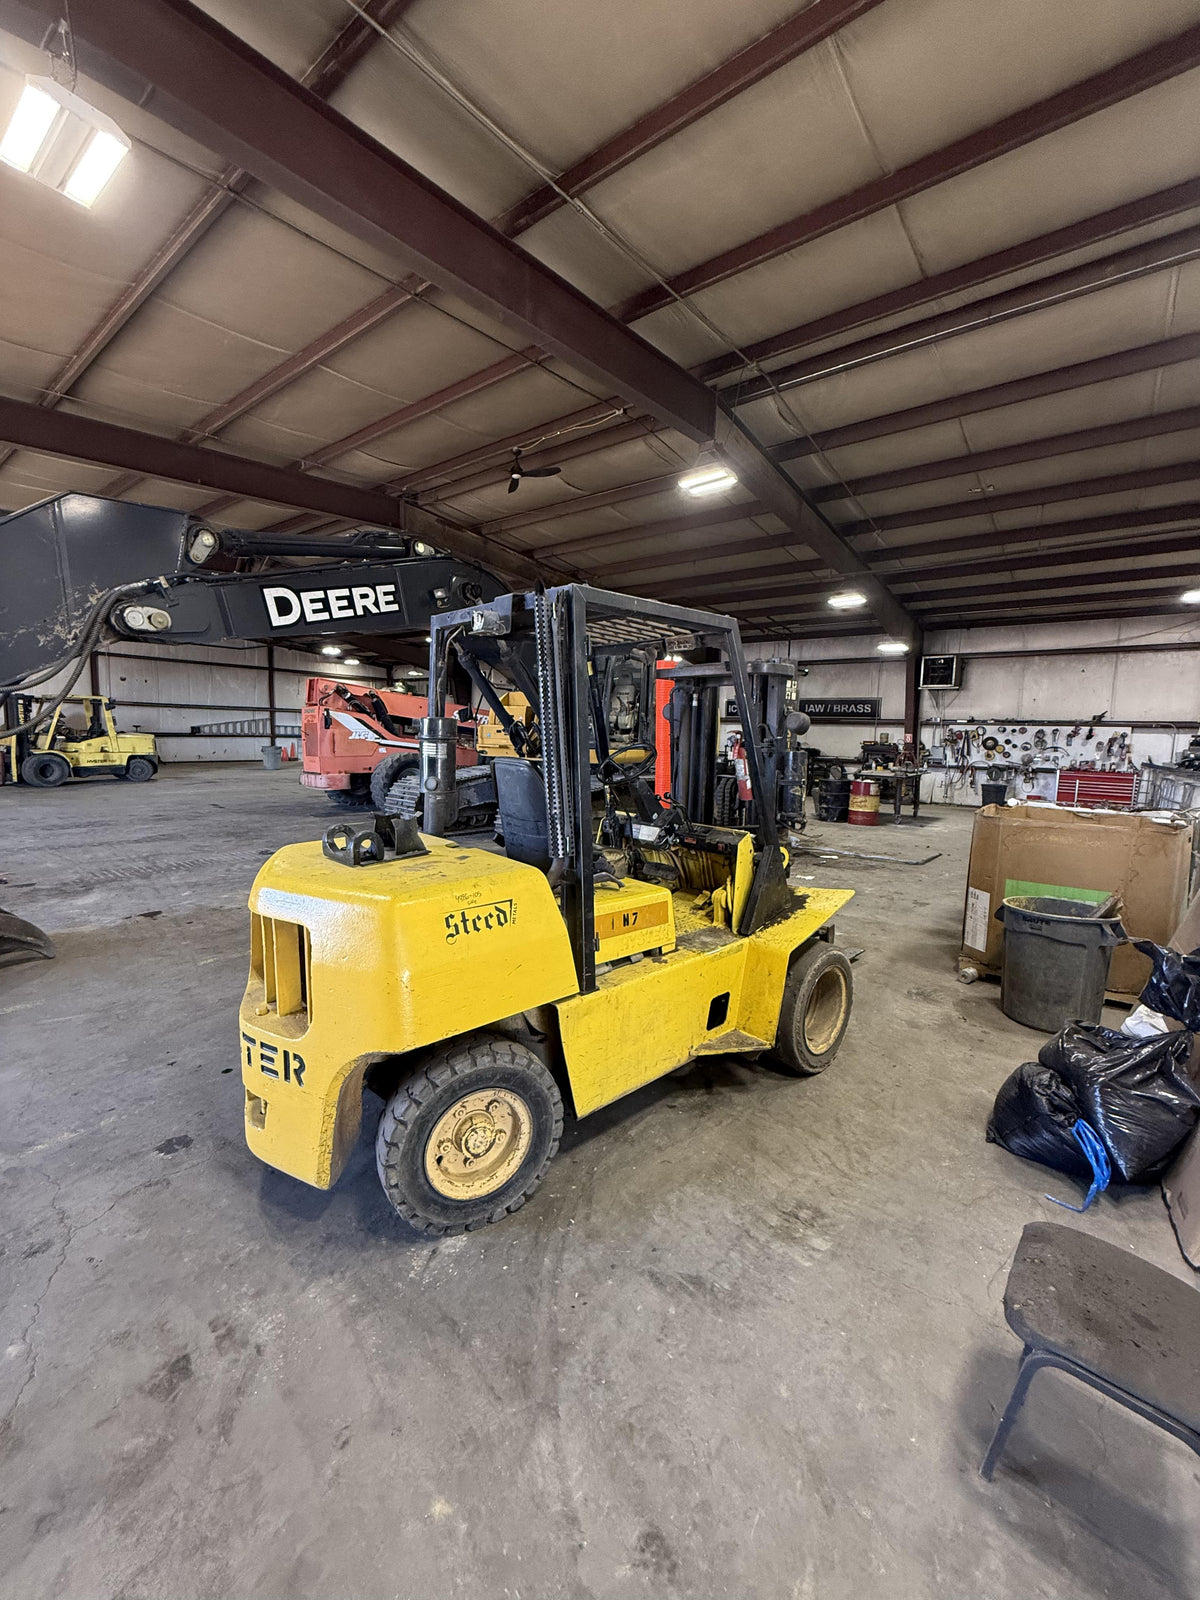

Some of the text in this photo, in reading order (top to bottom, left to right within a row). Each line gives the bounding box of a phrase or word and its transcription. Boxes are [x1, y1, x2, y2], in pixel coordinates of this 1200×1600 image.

[262, 584, 399, 627] DEERE
[832, 703, 872, 713] BRASS
[444, 905, 509, 946] Steed
